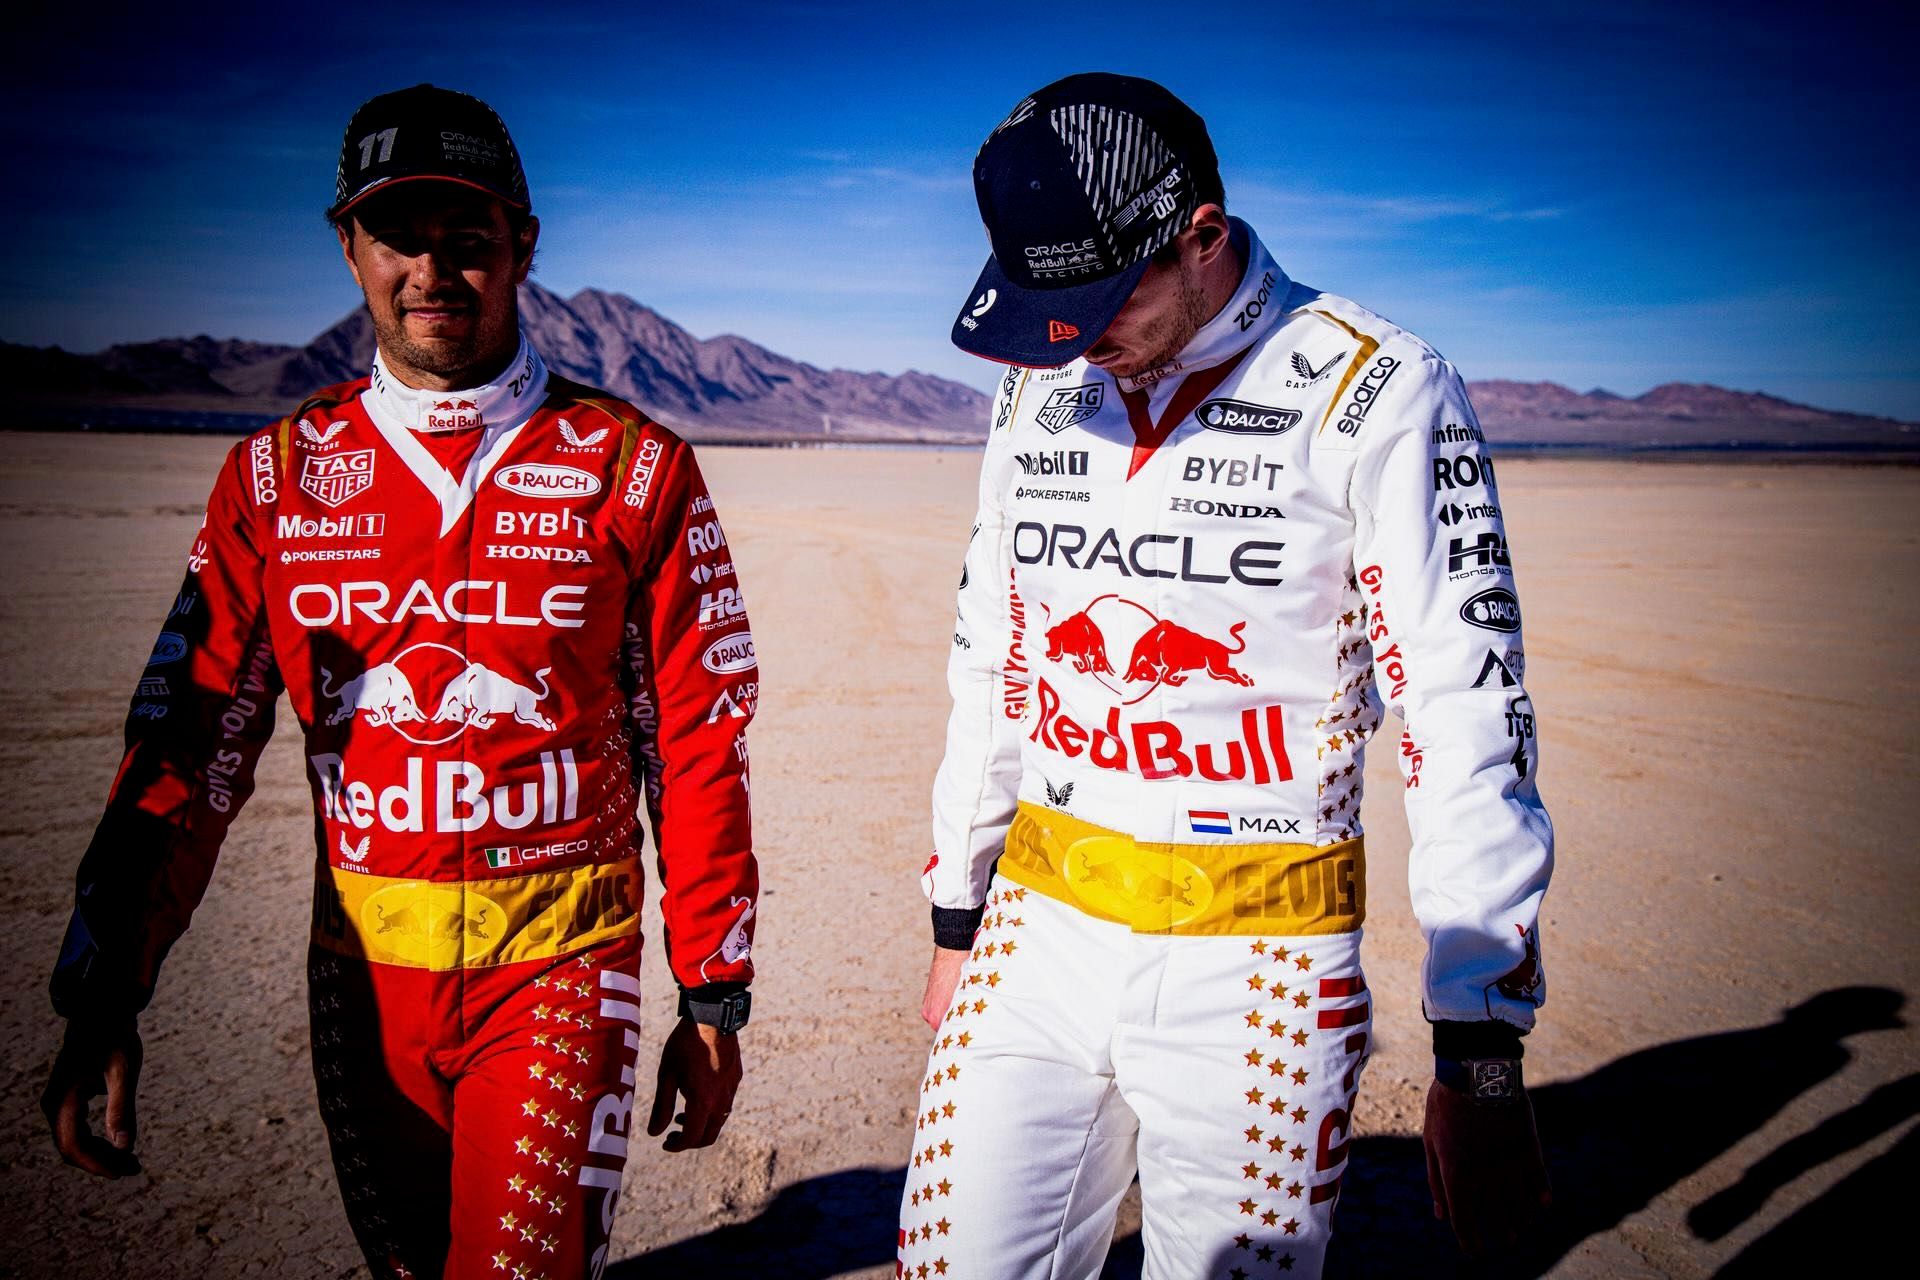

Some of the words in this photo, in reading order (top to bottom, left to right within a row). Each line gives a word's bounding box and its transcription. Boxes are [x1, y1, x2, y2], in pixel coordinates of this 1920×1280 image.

[358, 127, 398, 170] 11
[1130, 168, 1181, 218] Player
[1025, 238, 1095, 256] ORACLE
[1041, 369, 1072, 381] CASTORE
[1056, 387, 1099, 407] TAG
[1337, 355, 1401, 438] sparco
[1040, 406, 1095, 430] HEUER
[1224, 407, 1292, 431] RAUCH
[295, 440, 340, 451] CASTORE
[556, 444, 603, 454] CASTORE
[251, 435, 277, 505] sparco
[312, 454, 368, 476] TAG
[624, 439, 663, 510] sparco
[1014, 451, 1065, 476] Mobil
[1183, 454, 1284, 491] BYBIT
[305, 474, 368, 503] HEUER
[523, 471, 588, 491] RAUCH
[1024, 489, 1091, 502] POKERSTARS
[1169, 497, 1286, 519] HONDA
[277, 515, 354, 539] Mobil
[495, 507, 587, 538] BYBIT
[292, 549, 381, 562] POKERSTARS
[486, 545, 592, 563] HONDA
[1013, 521, 1286, 587] ORACLE
[1449, 567, 1495, 582] Honda
[289, 579, 588, 628] ORACLE
[698, 619, 729, 631] Honda
[243, 628, 275, 693] WIN
[721, 641, 755, 664] RAUC
[221, 698, 257, 741] YOU
[1030, 676, 1128, 771] Red
[1130, 705, 1293, 785] Bull
[207, 749, 242, 814] GIVES
[311, 752, 423, 833] Red
[436, 748, 578, 833] Bull
[1239, 817, 1301, 834] MAX
[522, 839, 588, 861] CHECO
[1233, 858, 1356, 919] ELVIS
